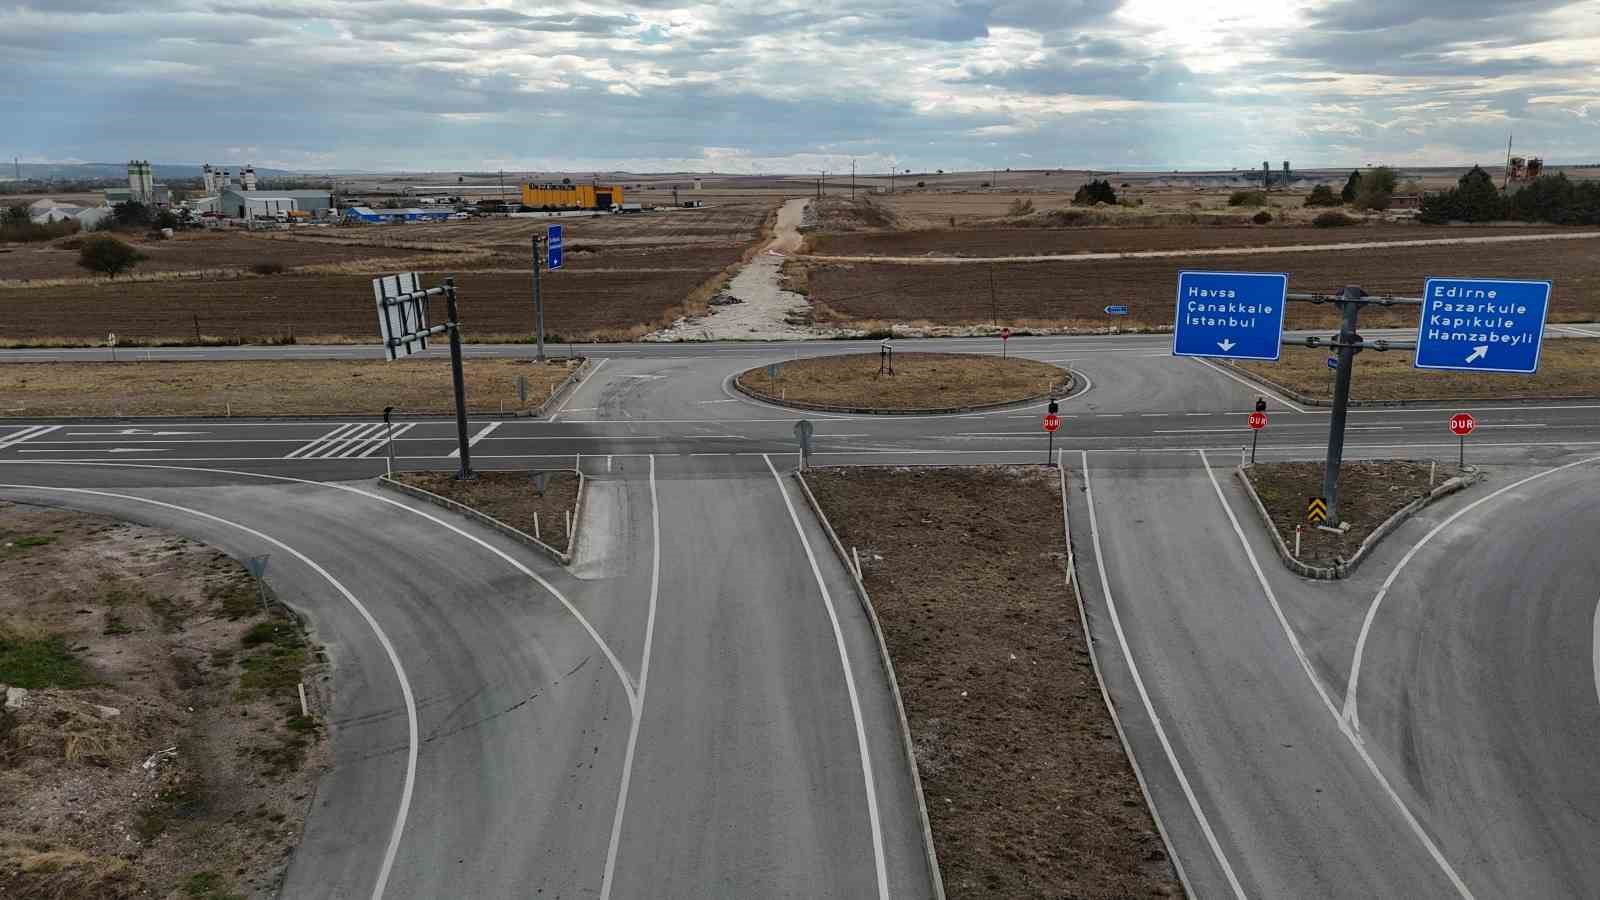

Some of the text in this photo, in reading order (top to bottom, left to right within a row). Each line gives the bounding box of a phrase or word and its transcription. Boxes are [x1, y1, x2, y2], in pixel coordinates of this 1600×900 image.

[1189, 287, 1236, 298] Havsa
[1434, 286, 1497, 299] Edirne
[1187, 301, 1273, 314] Çanakkale
[1432, 301, 1527, 314] Pazarkule
[1186, 313, 1256, 328] İstanbul
[1430, 314, 1514, 329] Kapıkule
[1428, 329, 1533, 346] Hamzabeyli
[1250, 416, 1268, 425] DUR
[1451, 419, 1473, 429] DUR
